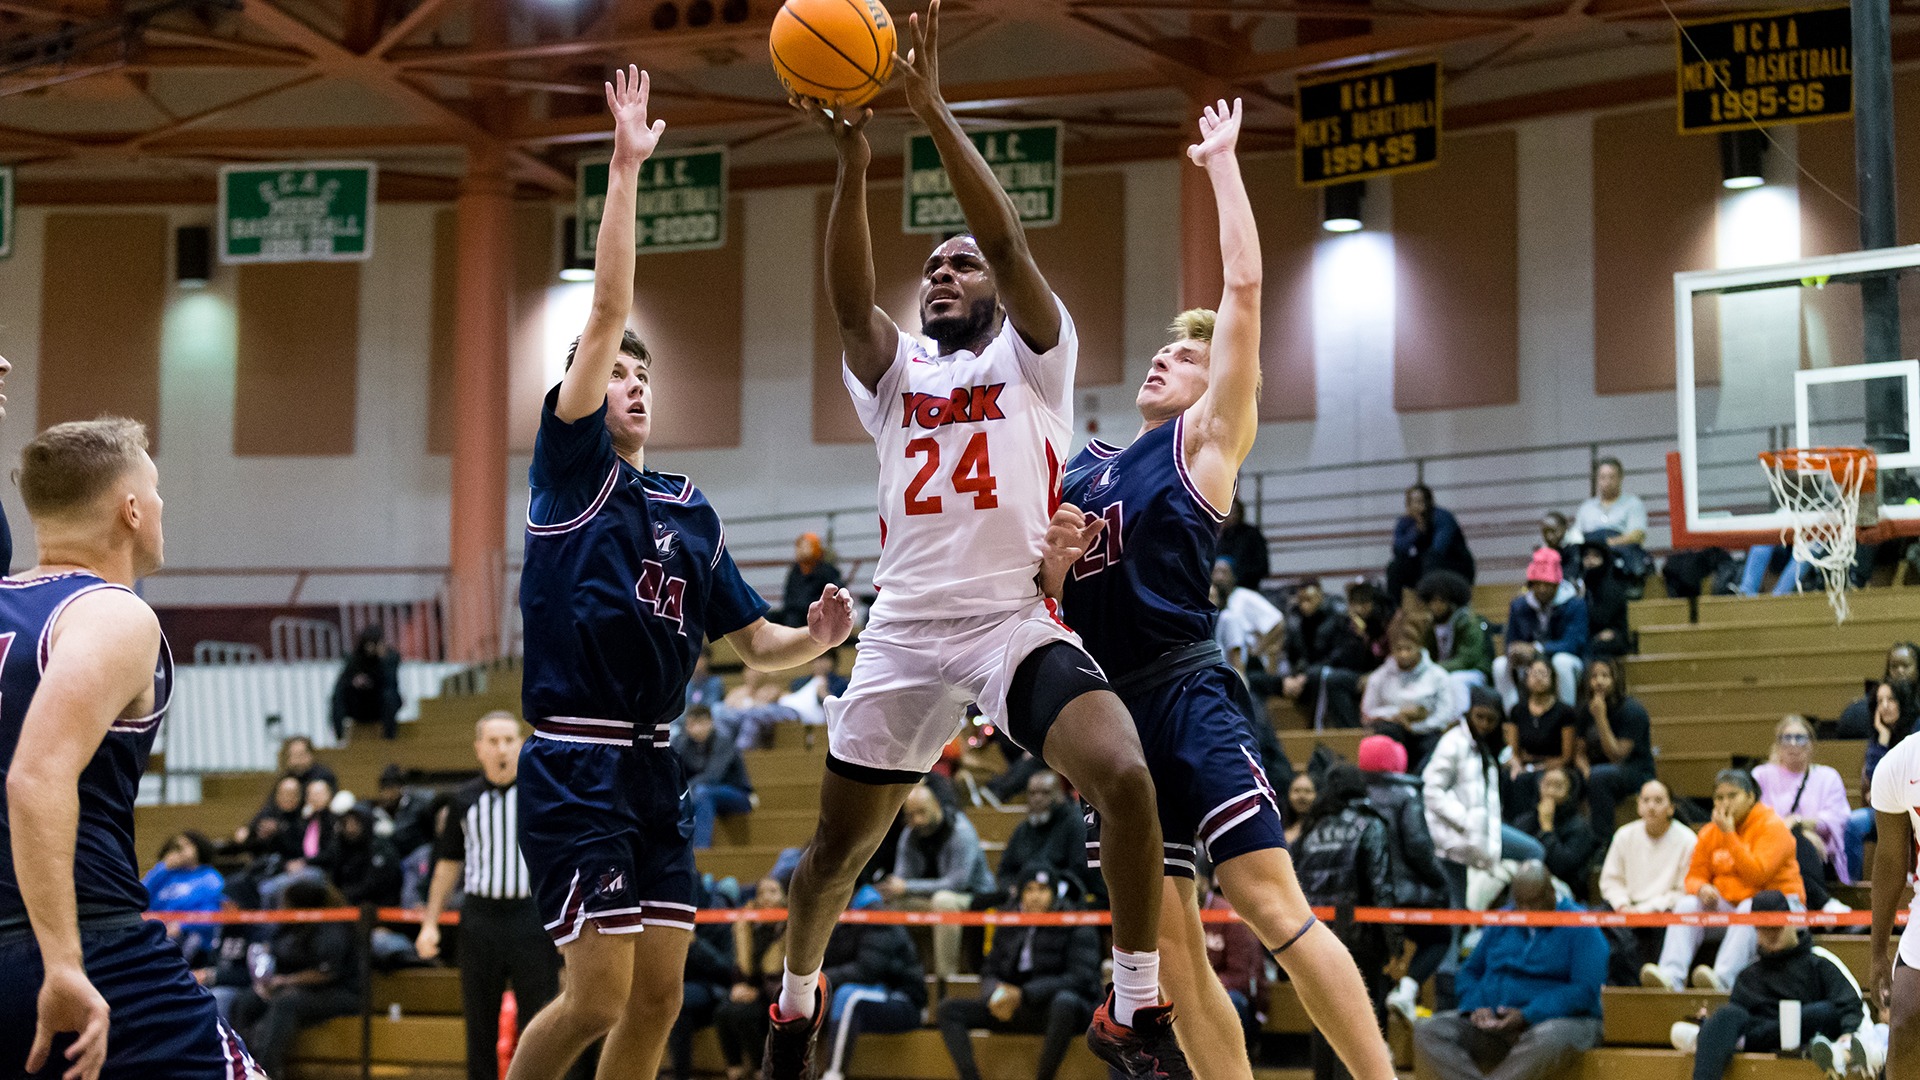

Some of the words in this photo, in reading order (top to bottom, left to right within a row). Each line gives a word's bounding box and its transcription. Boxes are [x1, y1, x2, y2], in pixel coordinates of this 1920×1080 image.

[1732, 17, 1799, 54] NCAA
[1745, 46, 1852, 85] BASKETBALL
[1340, 75, 1396, 112] NCAA
[1710, 81, 1825, 122] 1995-96
[1351, 99, 1436, 140] BASKETBALL
[901, 382, 1006, 430] YORK
[904, 432, 999, 516] 24
[1073, 500, 1124, 581] 21
[635, 558, 688, 637] 44
